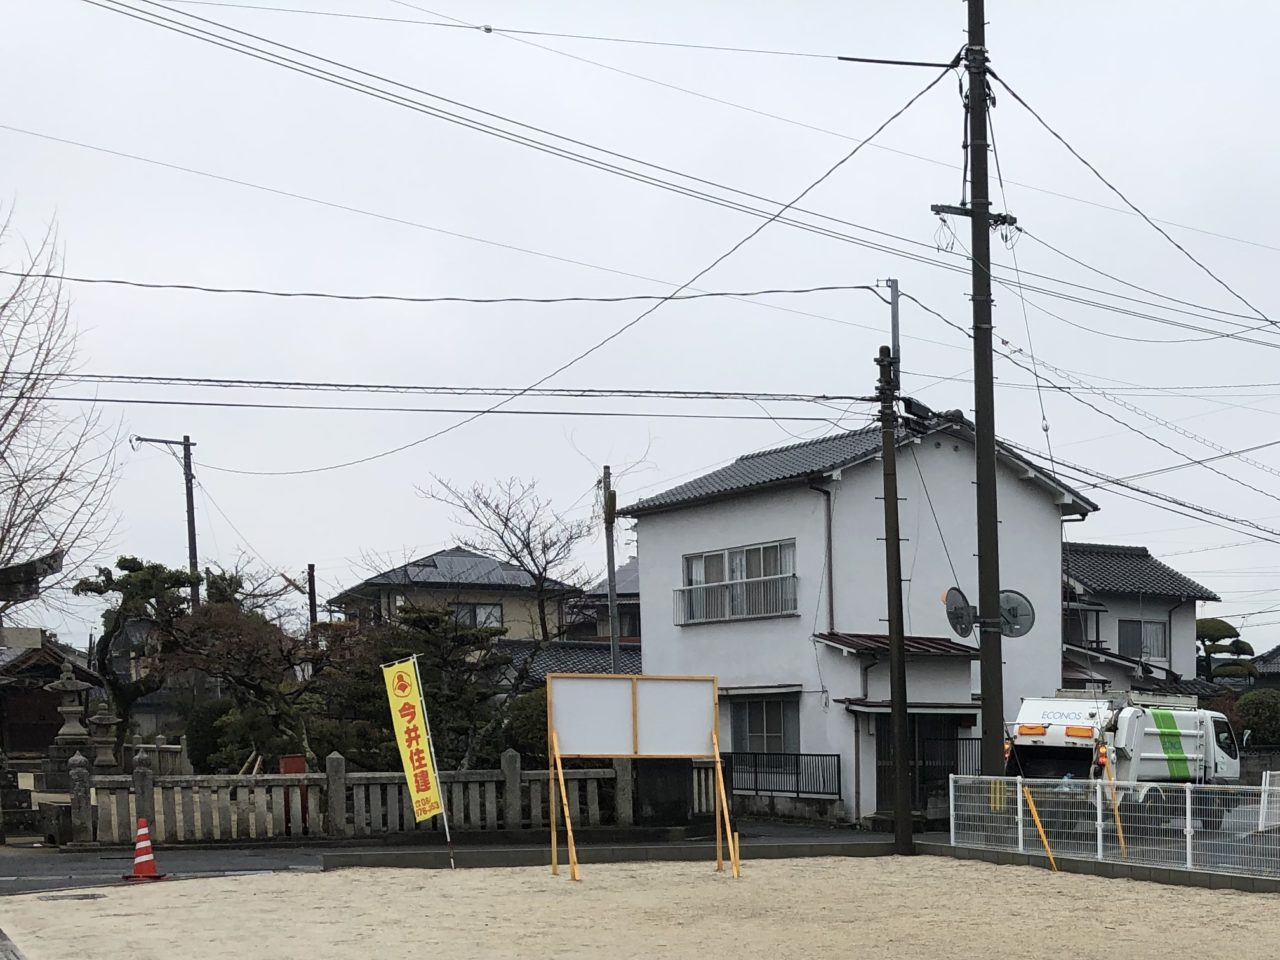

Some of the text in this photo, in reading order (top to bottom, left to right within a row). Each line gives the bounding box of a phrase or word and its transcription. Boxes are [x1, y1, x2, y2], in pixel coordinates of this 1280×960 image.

[1041, 711, 1082, 720] ECONOS
[398, 702, 432, 794] 今井住建
